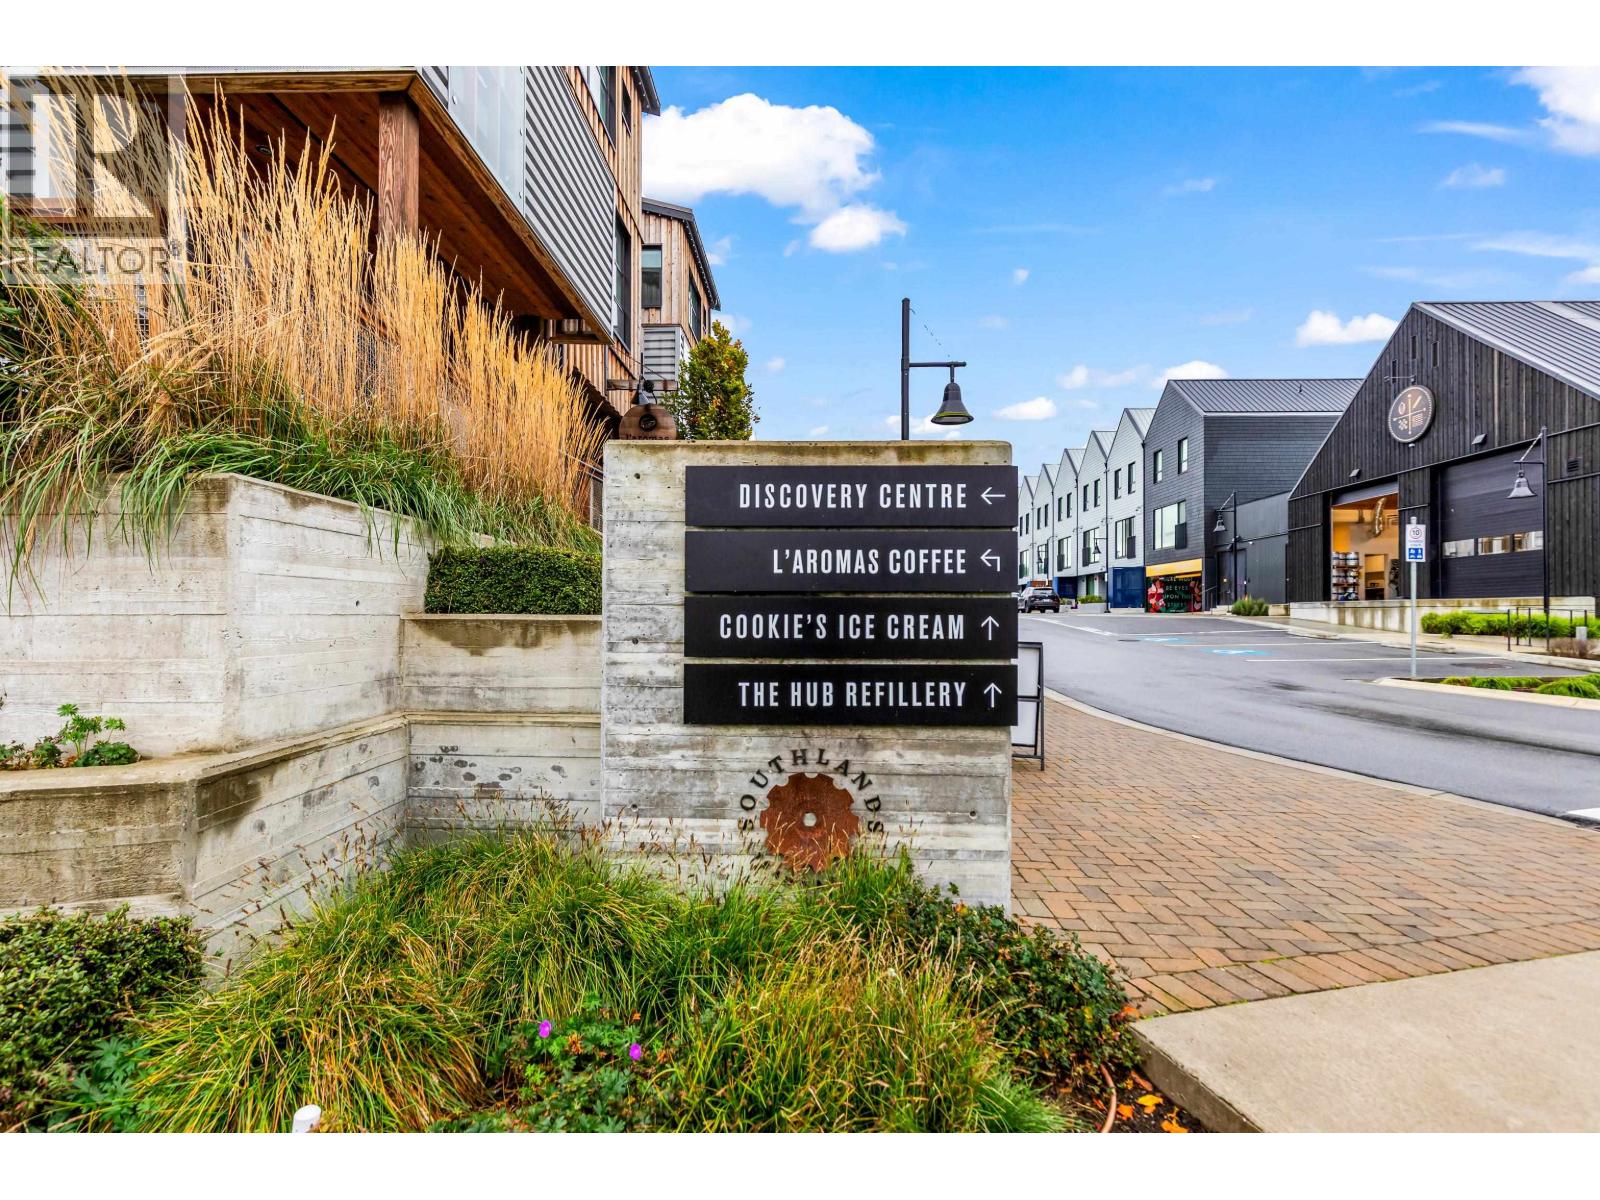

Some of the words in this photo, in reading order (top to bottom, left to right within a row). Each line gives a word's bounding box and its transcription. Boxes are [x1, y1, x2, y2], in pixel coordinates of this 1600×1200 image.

[739, 483, 867, 509] DISCOVERY
[879, 483, 967, 509] CENTRE
[773, 549, 879, 575] L'AROMAS
[888, 549, 967, 575] COFFEE
[719, 614, 827, 639] COOKIE'S
[839, 614, 875, 639] ICE
[887, 614, 964, 639] CREAM
[738, 682, 779, 706] THE
[790, 682, 834, 706] HUB
[846, 682, 966, 706] REFILLERY
[739, 749, 884, 833] SOUTHLANDS
